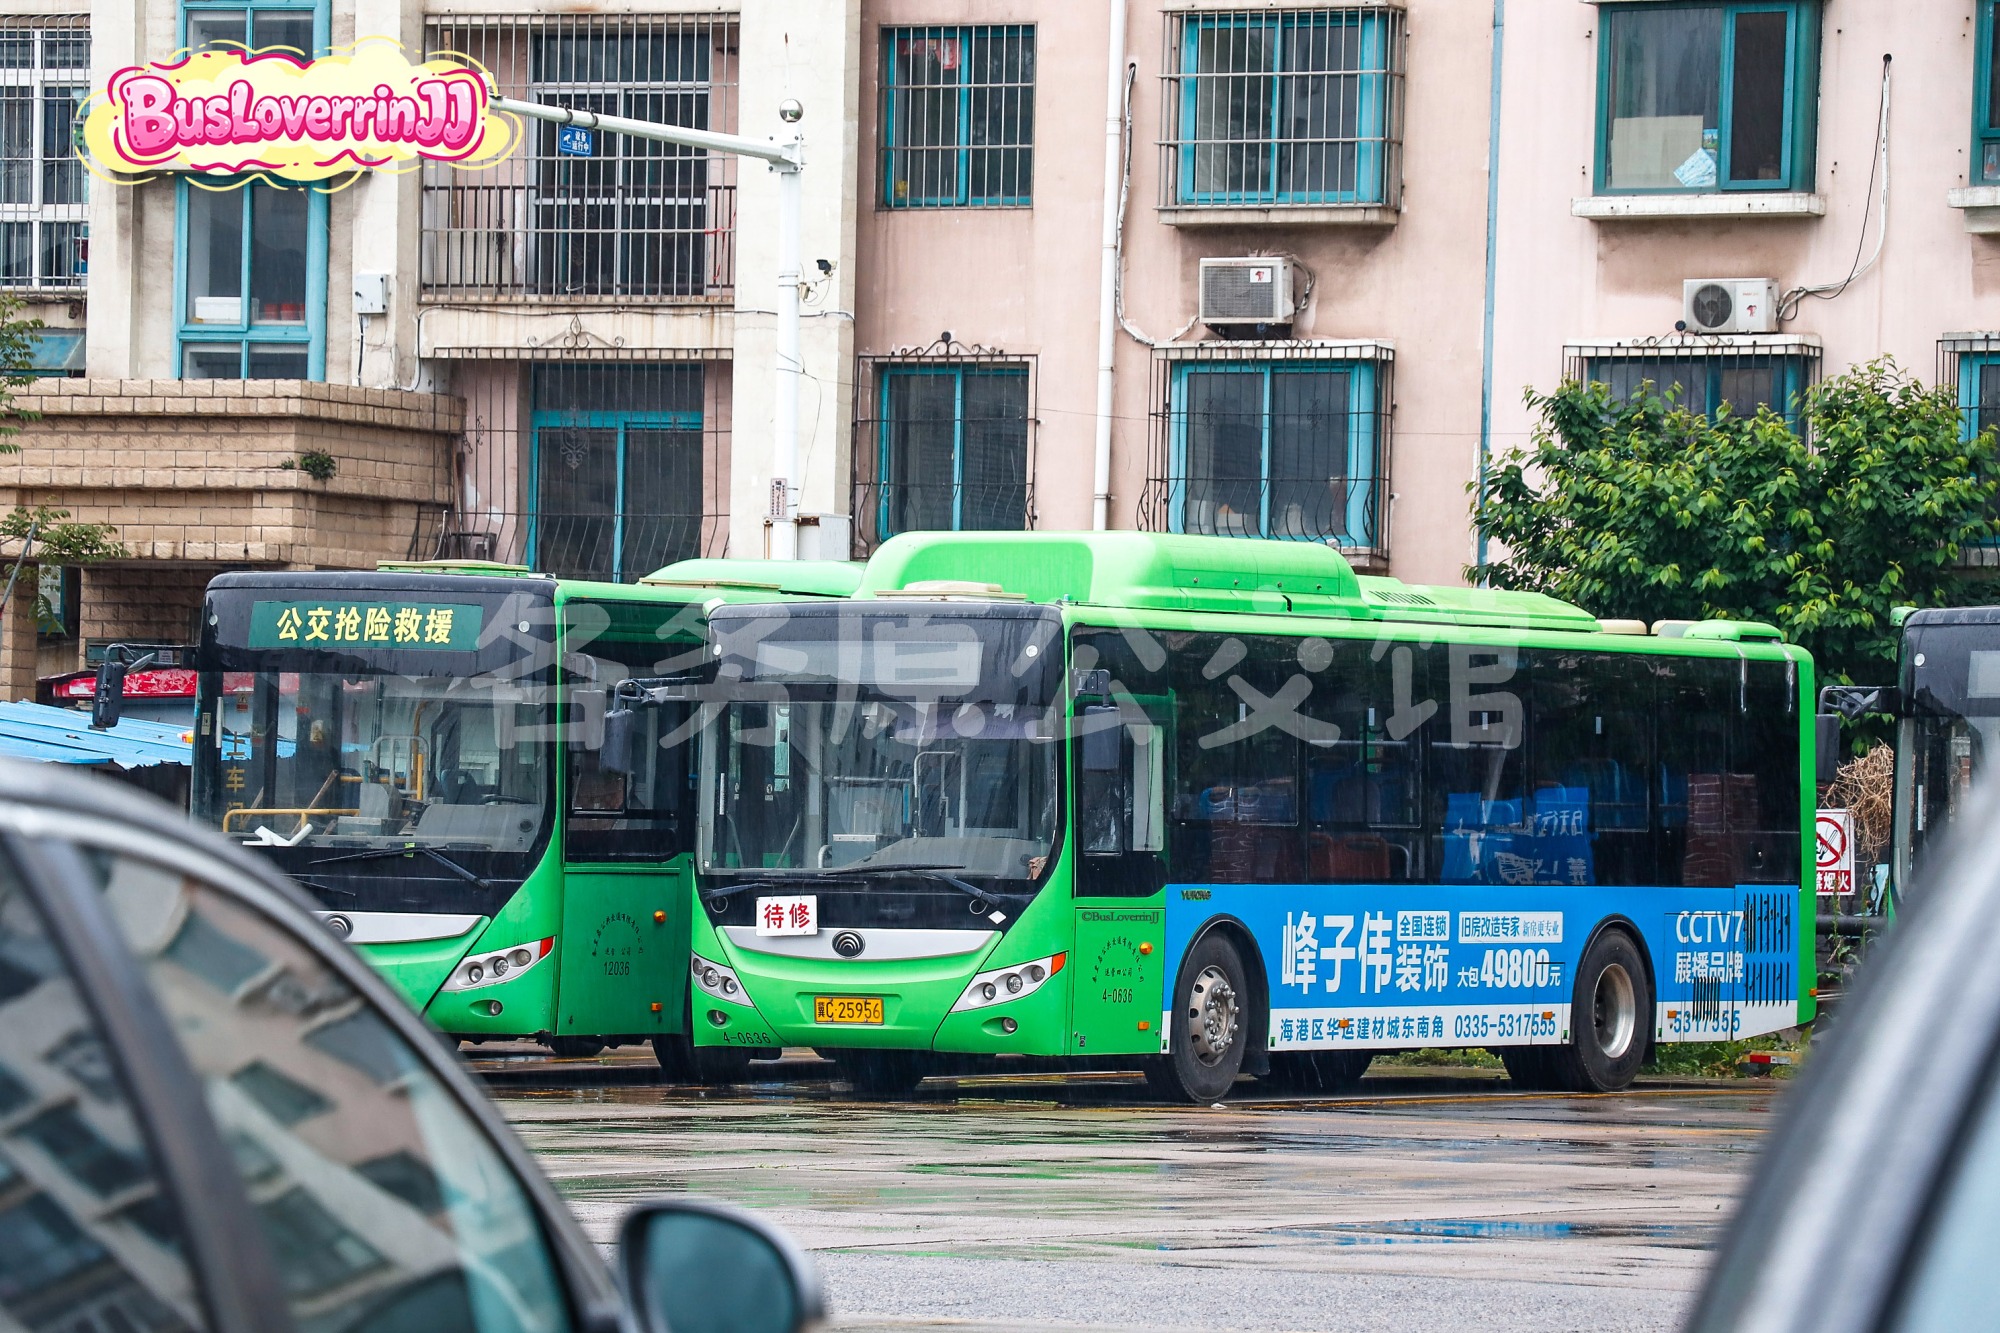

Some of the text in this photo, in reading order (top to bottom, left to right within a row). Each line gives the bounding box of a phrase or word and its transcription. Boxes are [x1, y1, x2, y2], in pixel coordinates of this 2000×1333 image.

[572, 141, 589, 152] 运行中
[276, 606, 454, 644] 公交抢险救援
[764, 903, 810, 929] 待修
[1400, 915, 1447, 937] 全国连锁
[1461, 916, 1520, 937] 旧房改造专家
[1675, 910, 1745, 944] CCTV7
[1281, 910, 1393, 995] 峰子伟
[603, 961, 630, 976] 12036
[1395, 943, 1450, 993] 装饰
[1674, 951, 1744, 984] 展播品牌
[1102, 988, 1133, 1004] 4-0636
[723, 1031, 771, 1044] 4-0636
[1280, 1013, 1556, 1042] 海港区华运建材城东南角 0335-5317555
